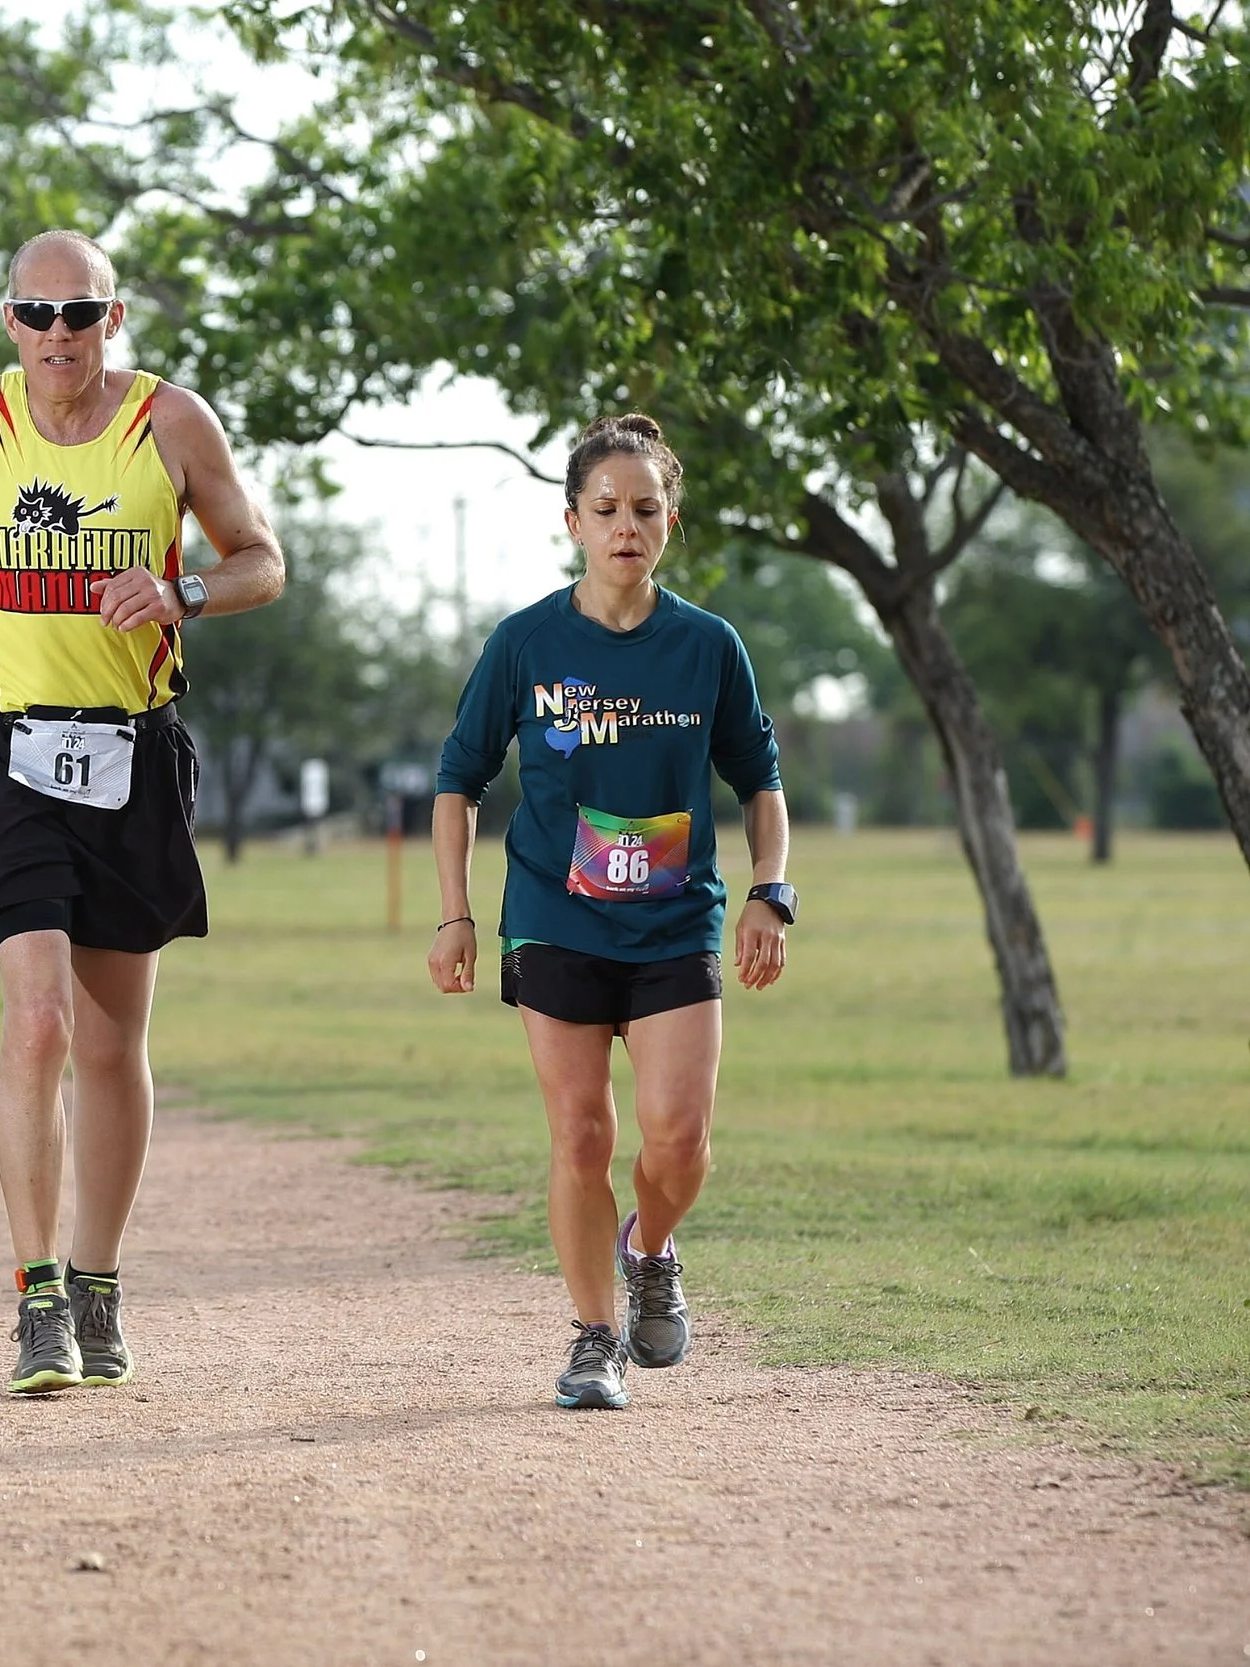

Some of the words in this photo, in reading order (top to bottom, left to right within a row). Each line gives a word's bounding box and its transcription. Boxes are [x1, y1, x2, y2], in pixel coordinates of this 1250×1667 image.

[533, 682, 597, 718] New
[579, 709, 701, 745] Marathon
[54, 752, 91, 787] 61
[607, 849, 649, 884] 86
